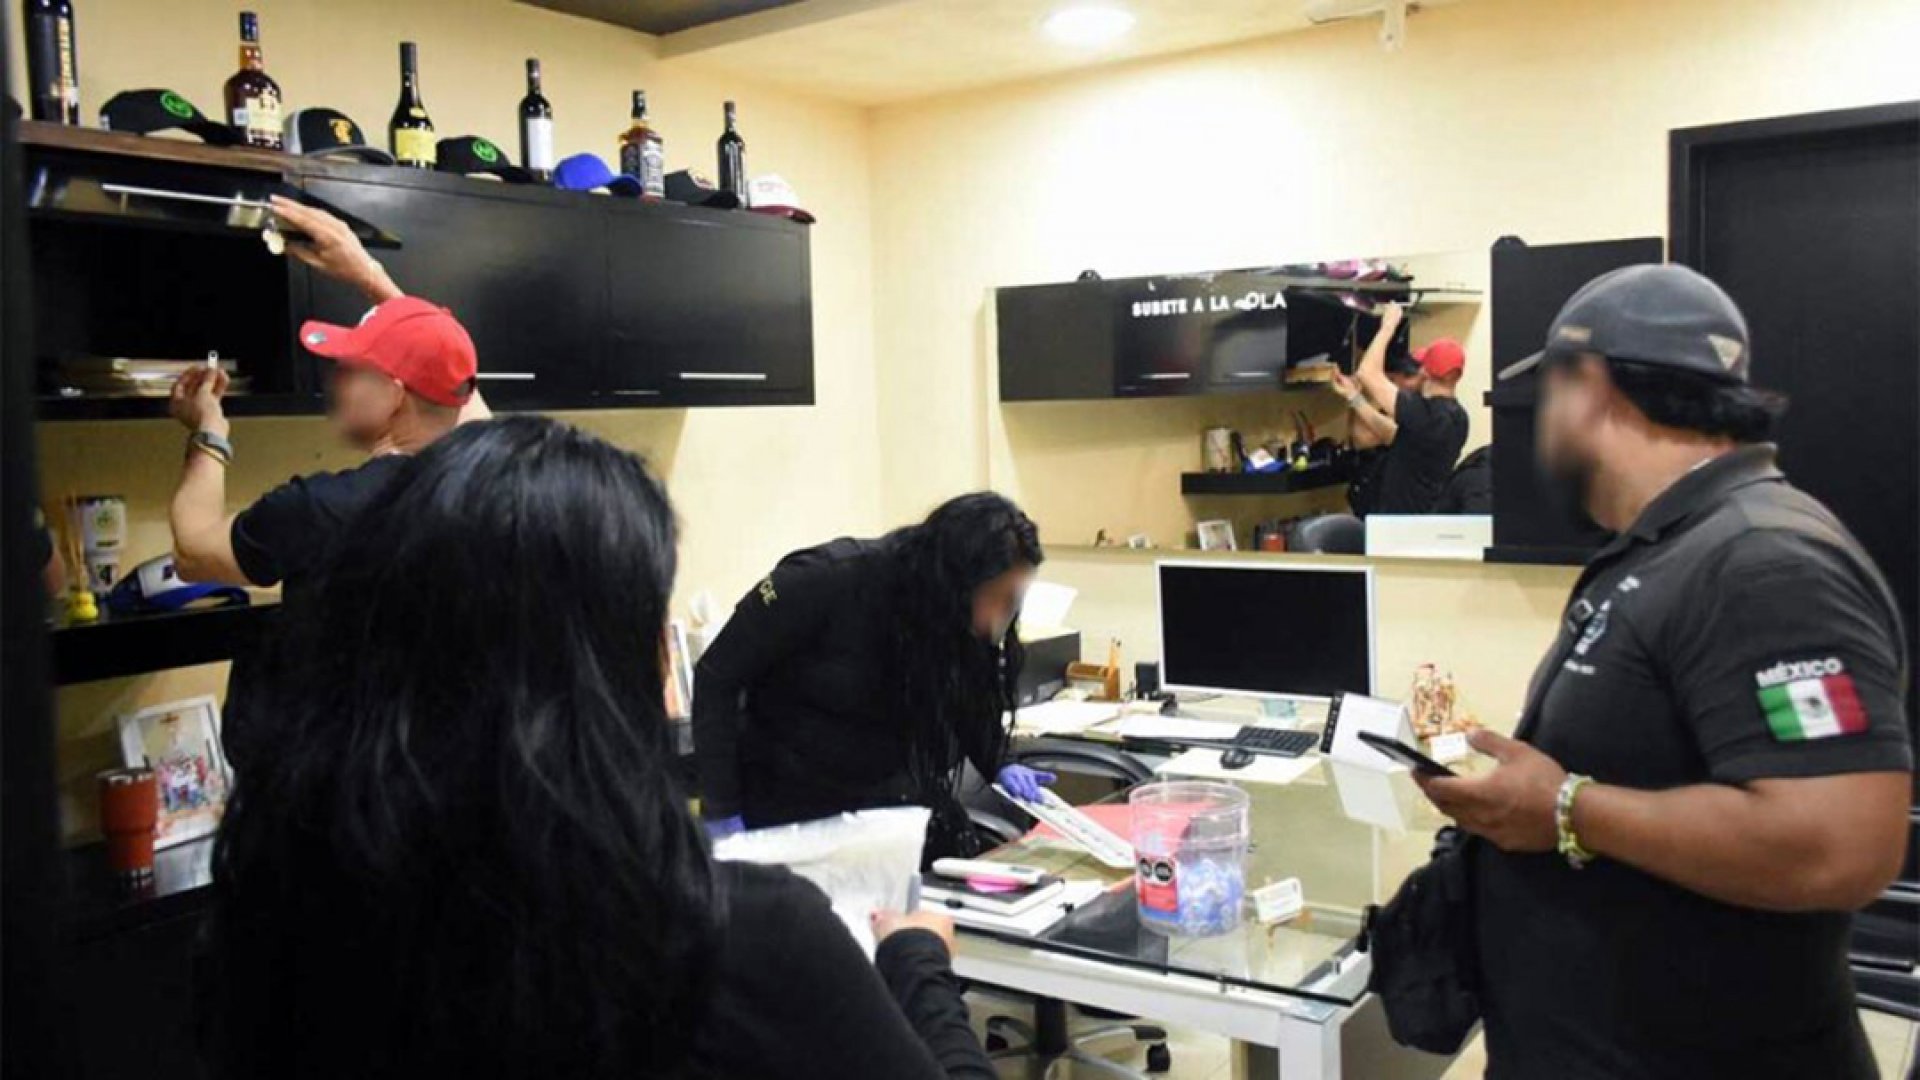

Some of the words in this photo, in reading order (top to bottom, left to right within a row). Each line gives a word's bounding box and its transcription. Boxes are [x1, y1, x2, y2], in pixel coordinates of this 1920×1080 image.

[1193, 297, 1205, 313] A
[1210, 295, 1230, 312] LA
[1245, 291, 1288, 310] OLA
